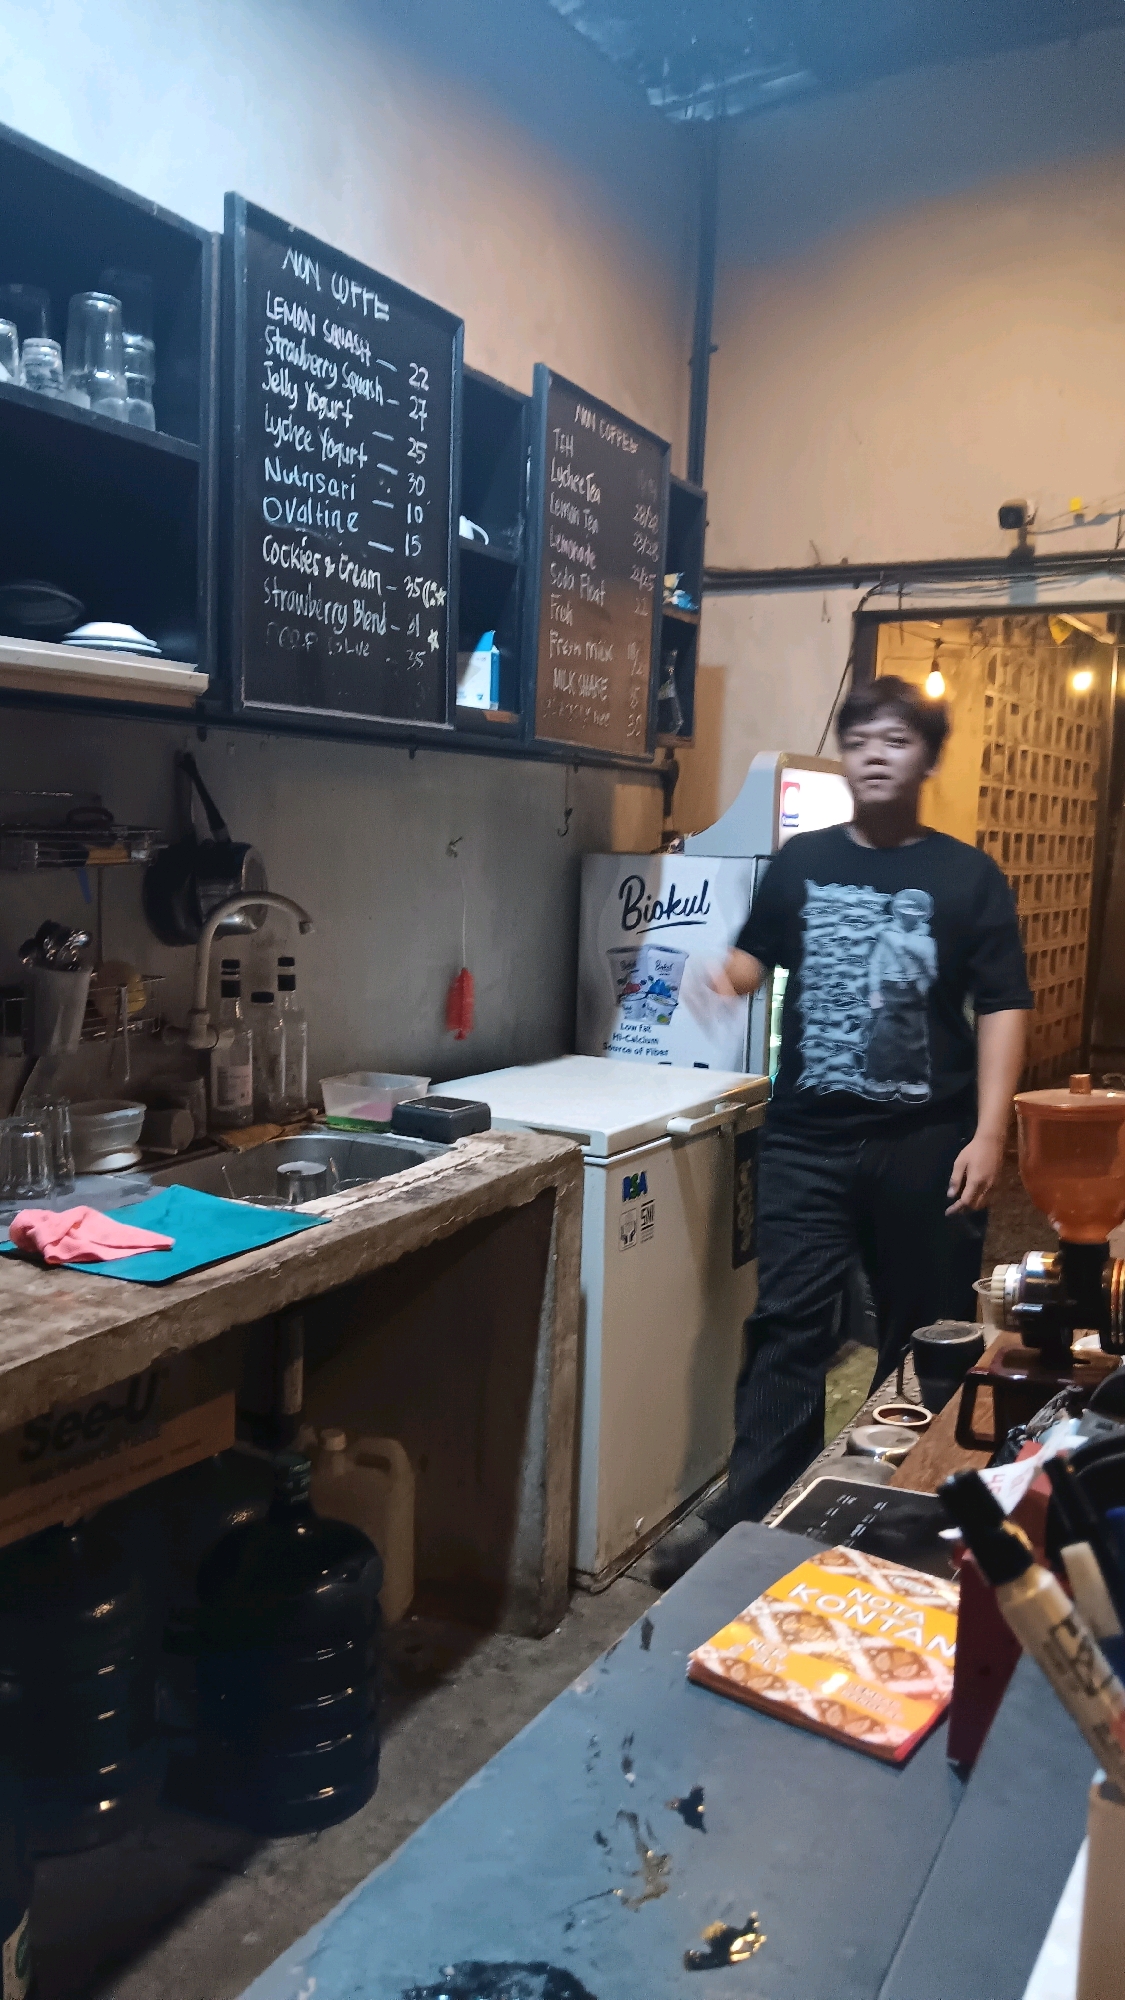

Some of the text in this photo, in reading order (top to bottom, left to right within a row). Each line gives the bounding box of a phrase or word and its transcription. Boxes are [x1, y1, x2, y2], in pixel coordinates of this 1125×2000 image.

[282, 248, 321, 291] NON
[266, 290, 430, 391] LEMON SQUASH 22
[264, 324, 428, 432] Strawberry Squash 27
[261, 360, 428, 464] Jelly Yogurt 25
[264, 402, 426, 496] Lychee Yogurt 30
[264, 456, 424, 524] Nutrisari 10
[338, 552, 383, 596] Cream
[403, 575, 424, 599] 35
[404, 533, 422, 557] 15
[263, 575, 348, 635] Strawberry
[352, 598, 387, 636] Blend
[618, 874, 712, 932] Biokul
[787, 1582, 958, 1659] KONTAN
[848, 1586, 926, 1625] NOTA
